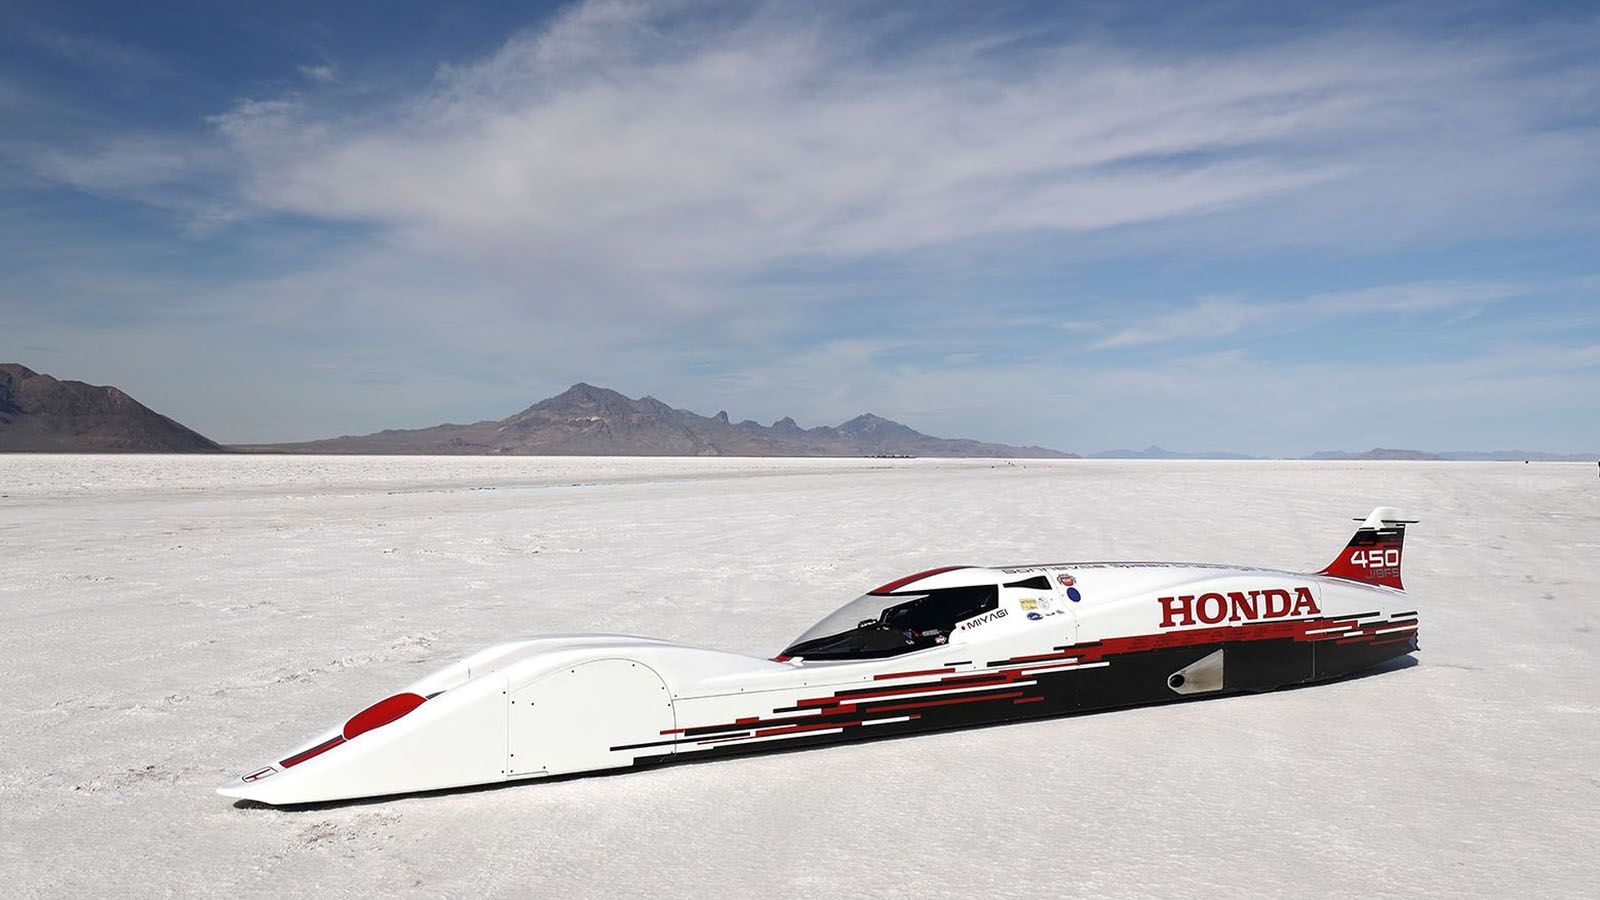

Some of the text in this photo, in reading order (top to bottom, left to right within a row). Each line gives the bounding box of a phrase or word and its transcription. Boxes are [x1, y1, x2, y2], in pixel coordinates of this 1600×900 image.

[1350, 549, 1399, 568] 450
[1158, 587, 1321, 628] HONDA
[967, 609, 1008, 629] MIYAGI
